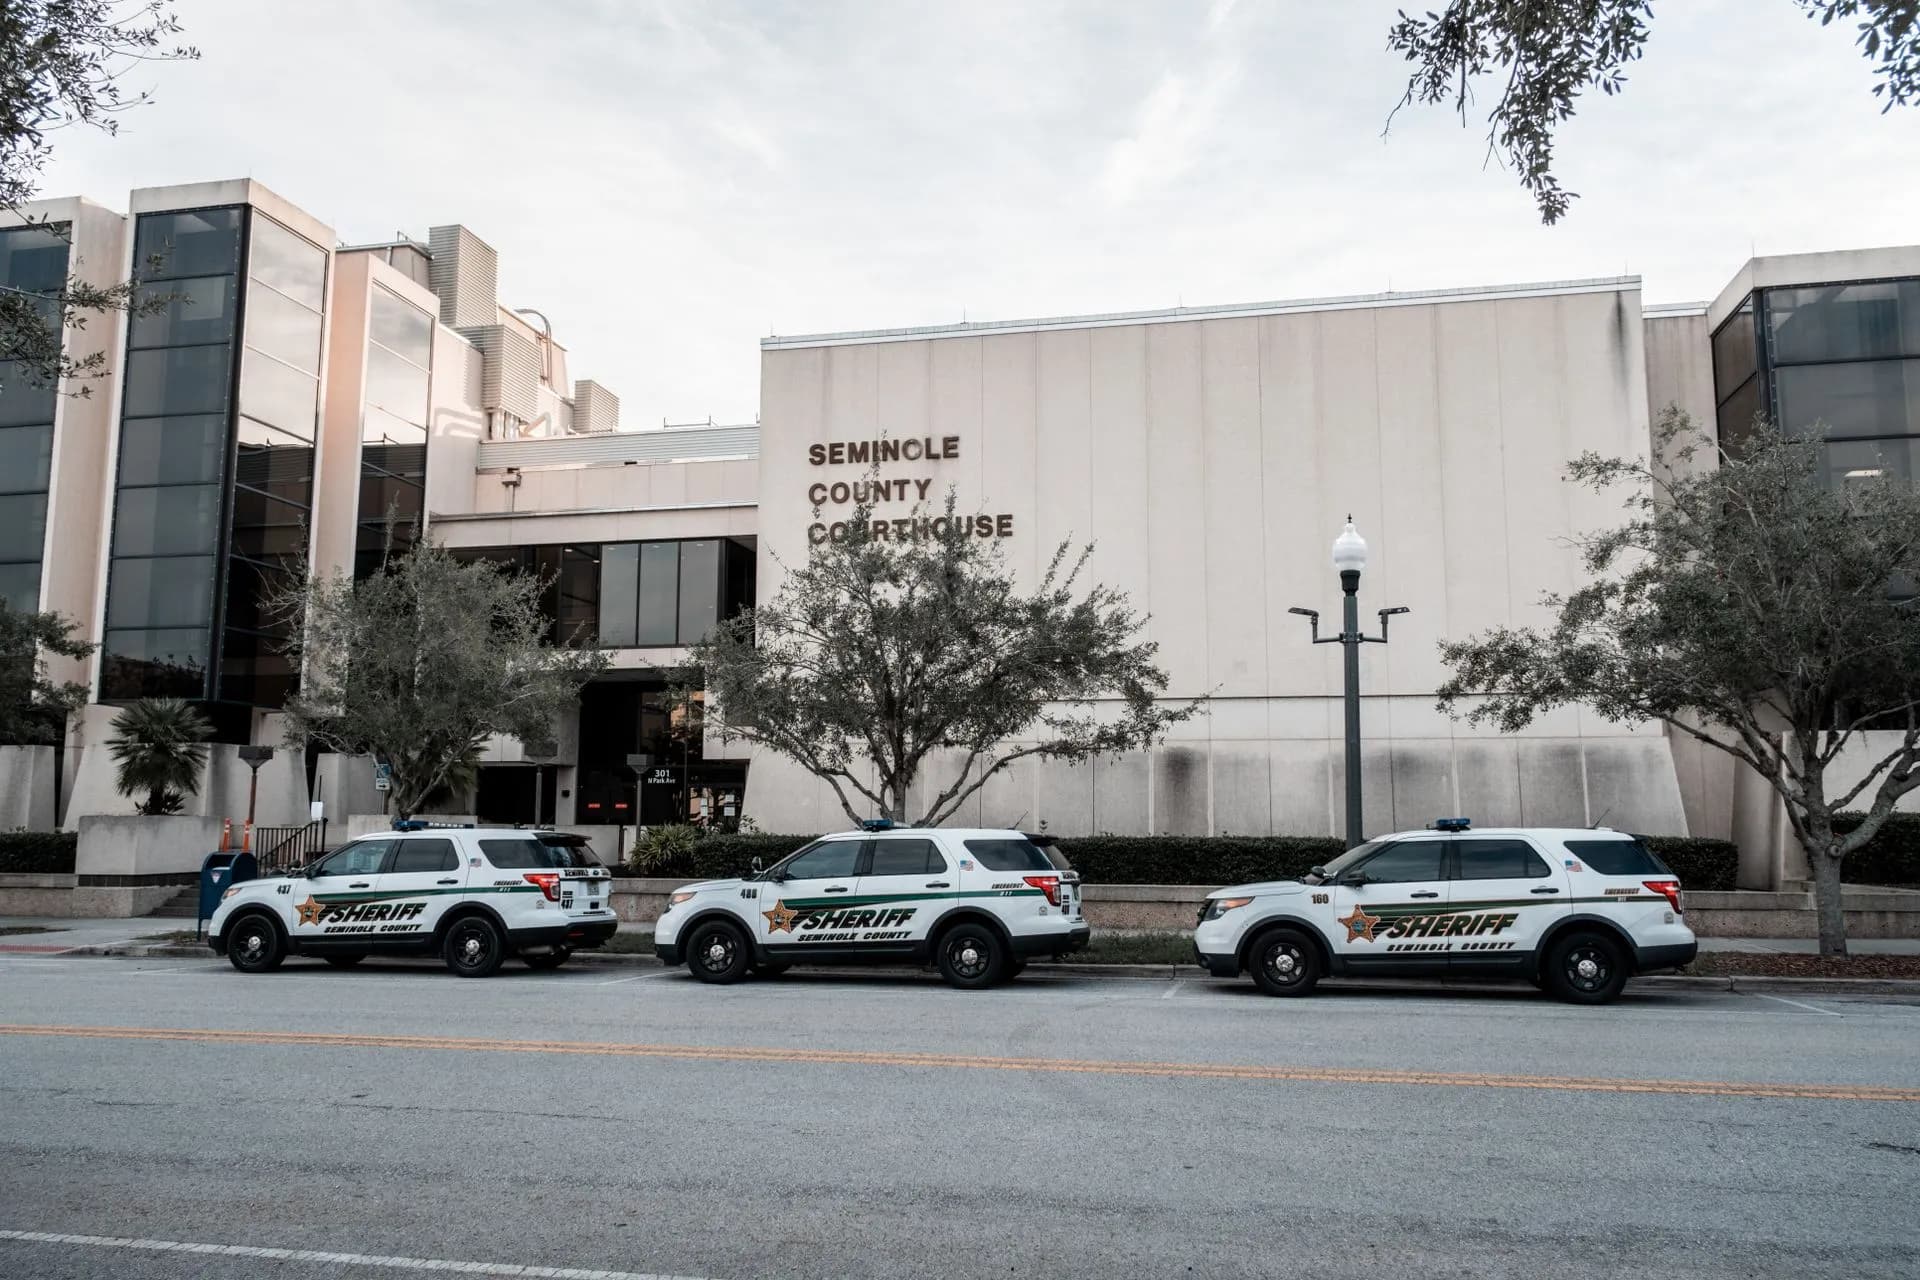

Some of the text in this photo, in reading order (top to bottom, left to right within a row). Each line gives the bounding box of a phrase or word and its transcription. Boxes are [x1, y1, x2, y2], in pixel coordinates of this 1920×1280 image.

[809, 436, 960, 466] SEMINOLE
[808, 478, 932, 505] COUNTY
[655, 769, 670, 778] 301
[1311, 894, 1329, 904] 160
[327, 903, 427, 923] SHERIFF
[801, 908, 917, 930] SHERIFF
[324, 924, 422, 934] SEMINOLE COUNTY
[1386, 913, 1519, 939] SHERIFF
[797, 931, 912, 942] SEMINOLE COUNTY
[1386, 942, 1516, 952] SEMINOLE COUNTY
